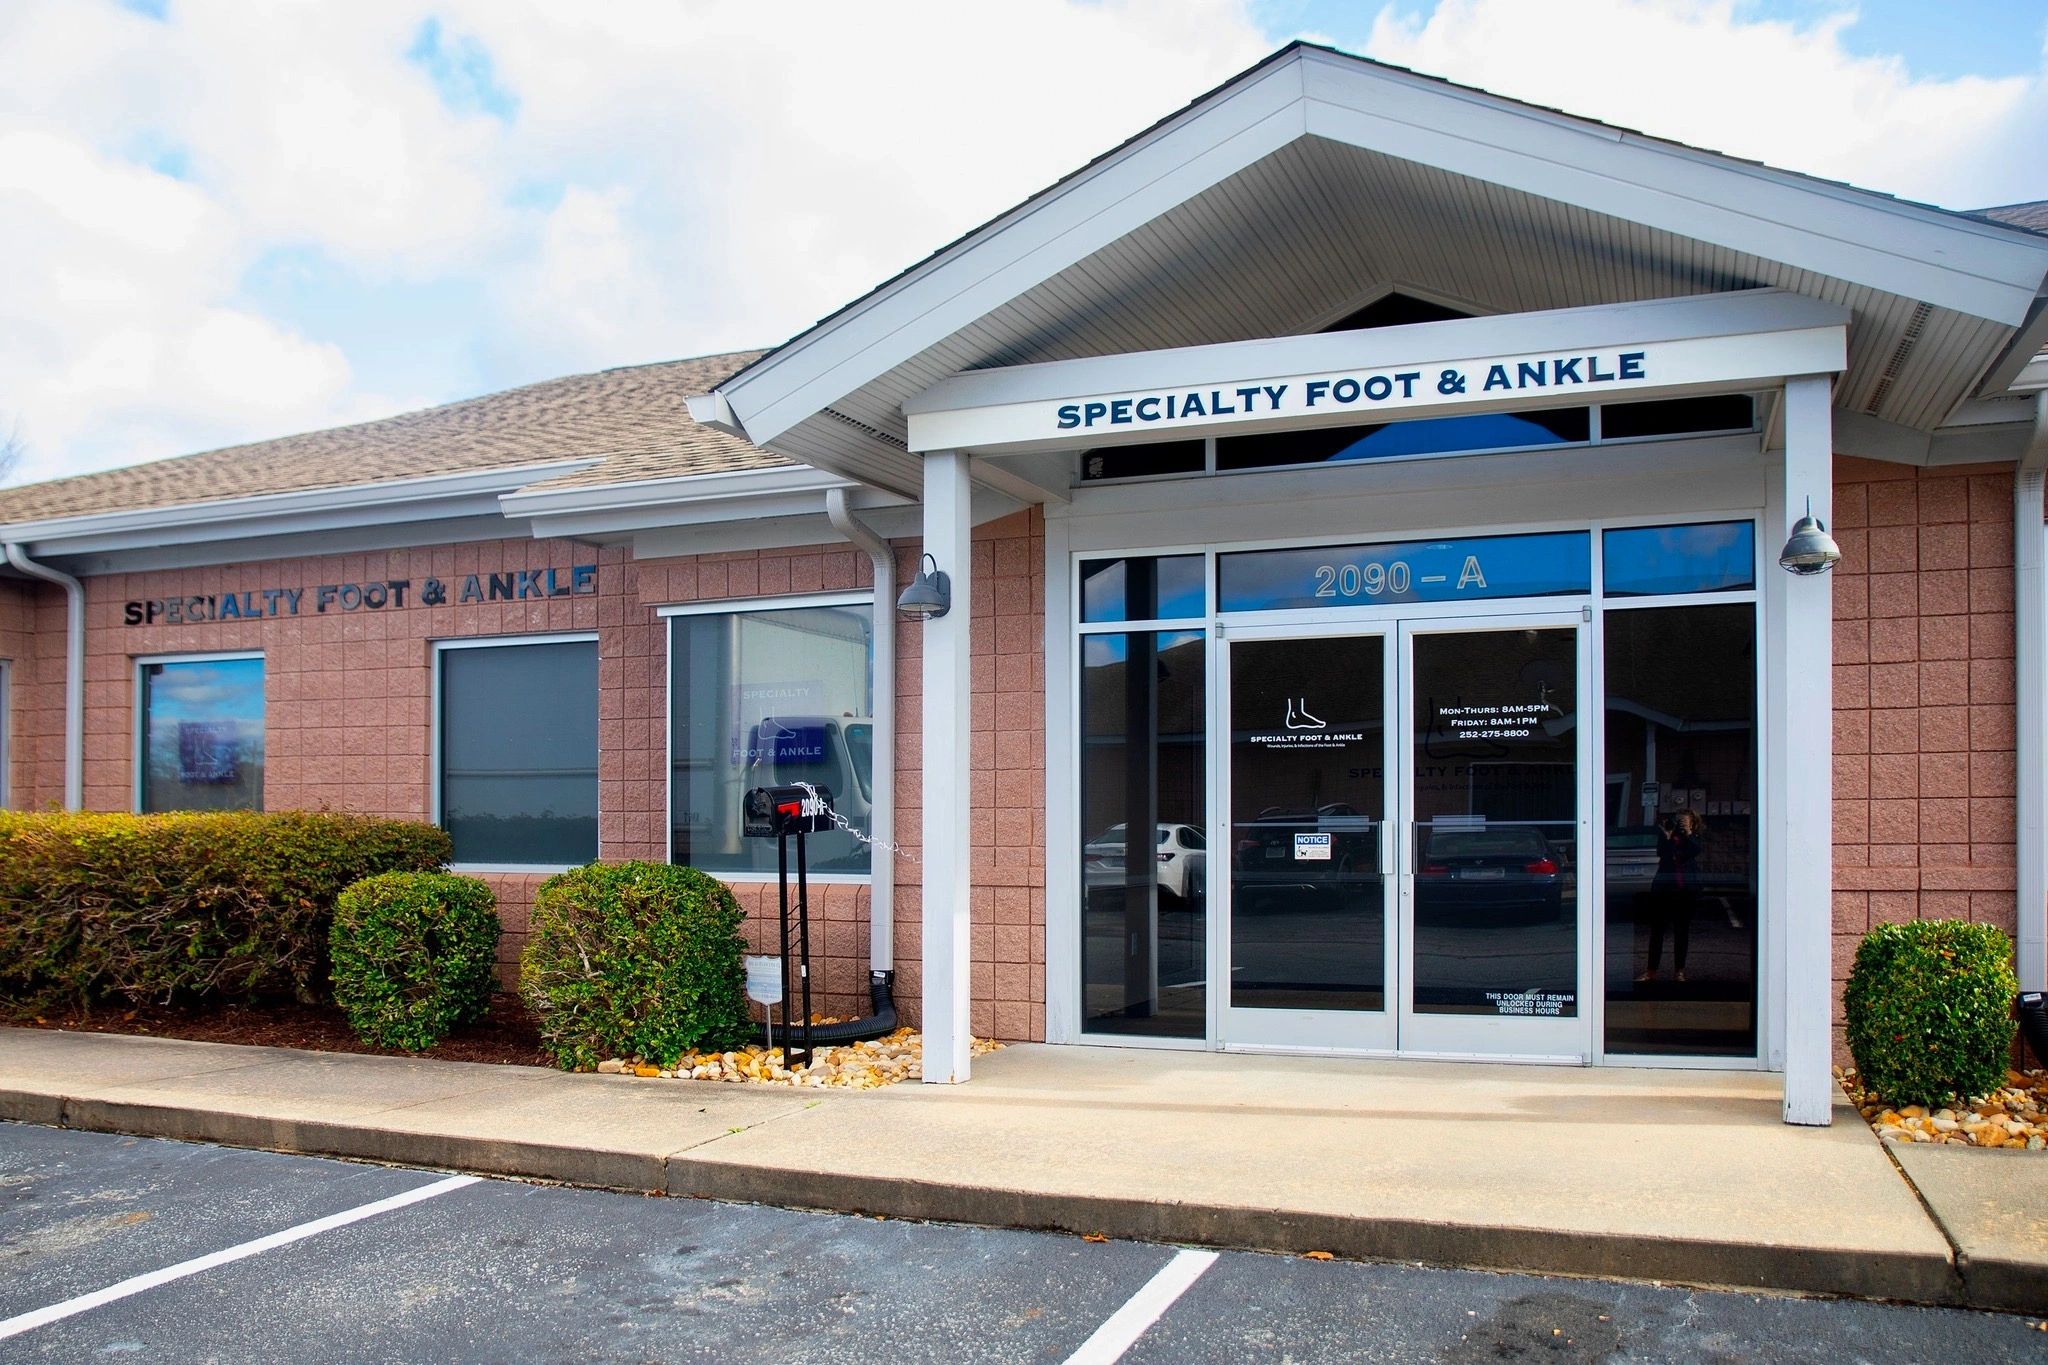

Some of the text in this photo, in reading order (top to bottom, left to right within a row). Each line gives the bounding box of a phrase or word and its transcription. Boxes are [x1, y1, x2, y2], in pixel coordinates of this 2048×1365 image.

[1057, 351, 1646, 429] SPECIALTY FOOT & ANKLE
[1315, 561, 1411, 598] 2090
[1456, 555, 1487, 590] A
[124, 564, 598, 626] SPECIALTY FOOT & ANKLE
[744, 687, 810, 699] SPECIALTY
[1502, 705, 1549, 713] 8AM-5PM
[1451, 717, 1537, 727] FRIDAY: 8AM-1PM
[1333, 733, 1363, 741] ANKLE
[1460, 730, 1529, 738] 252-275-8800
[733, 746, 821, 758] FOOT & ANKLE
[1297, 836, 1328, 844] NOTICE
